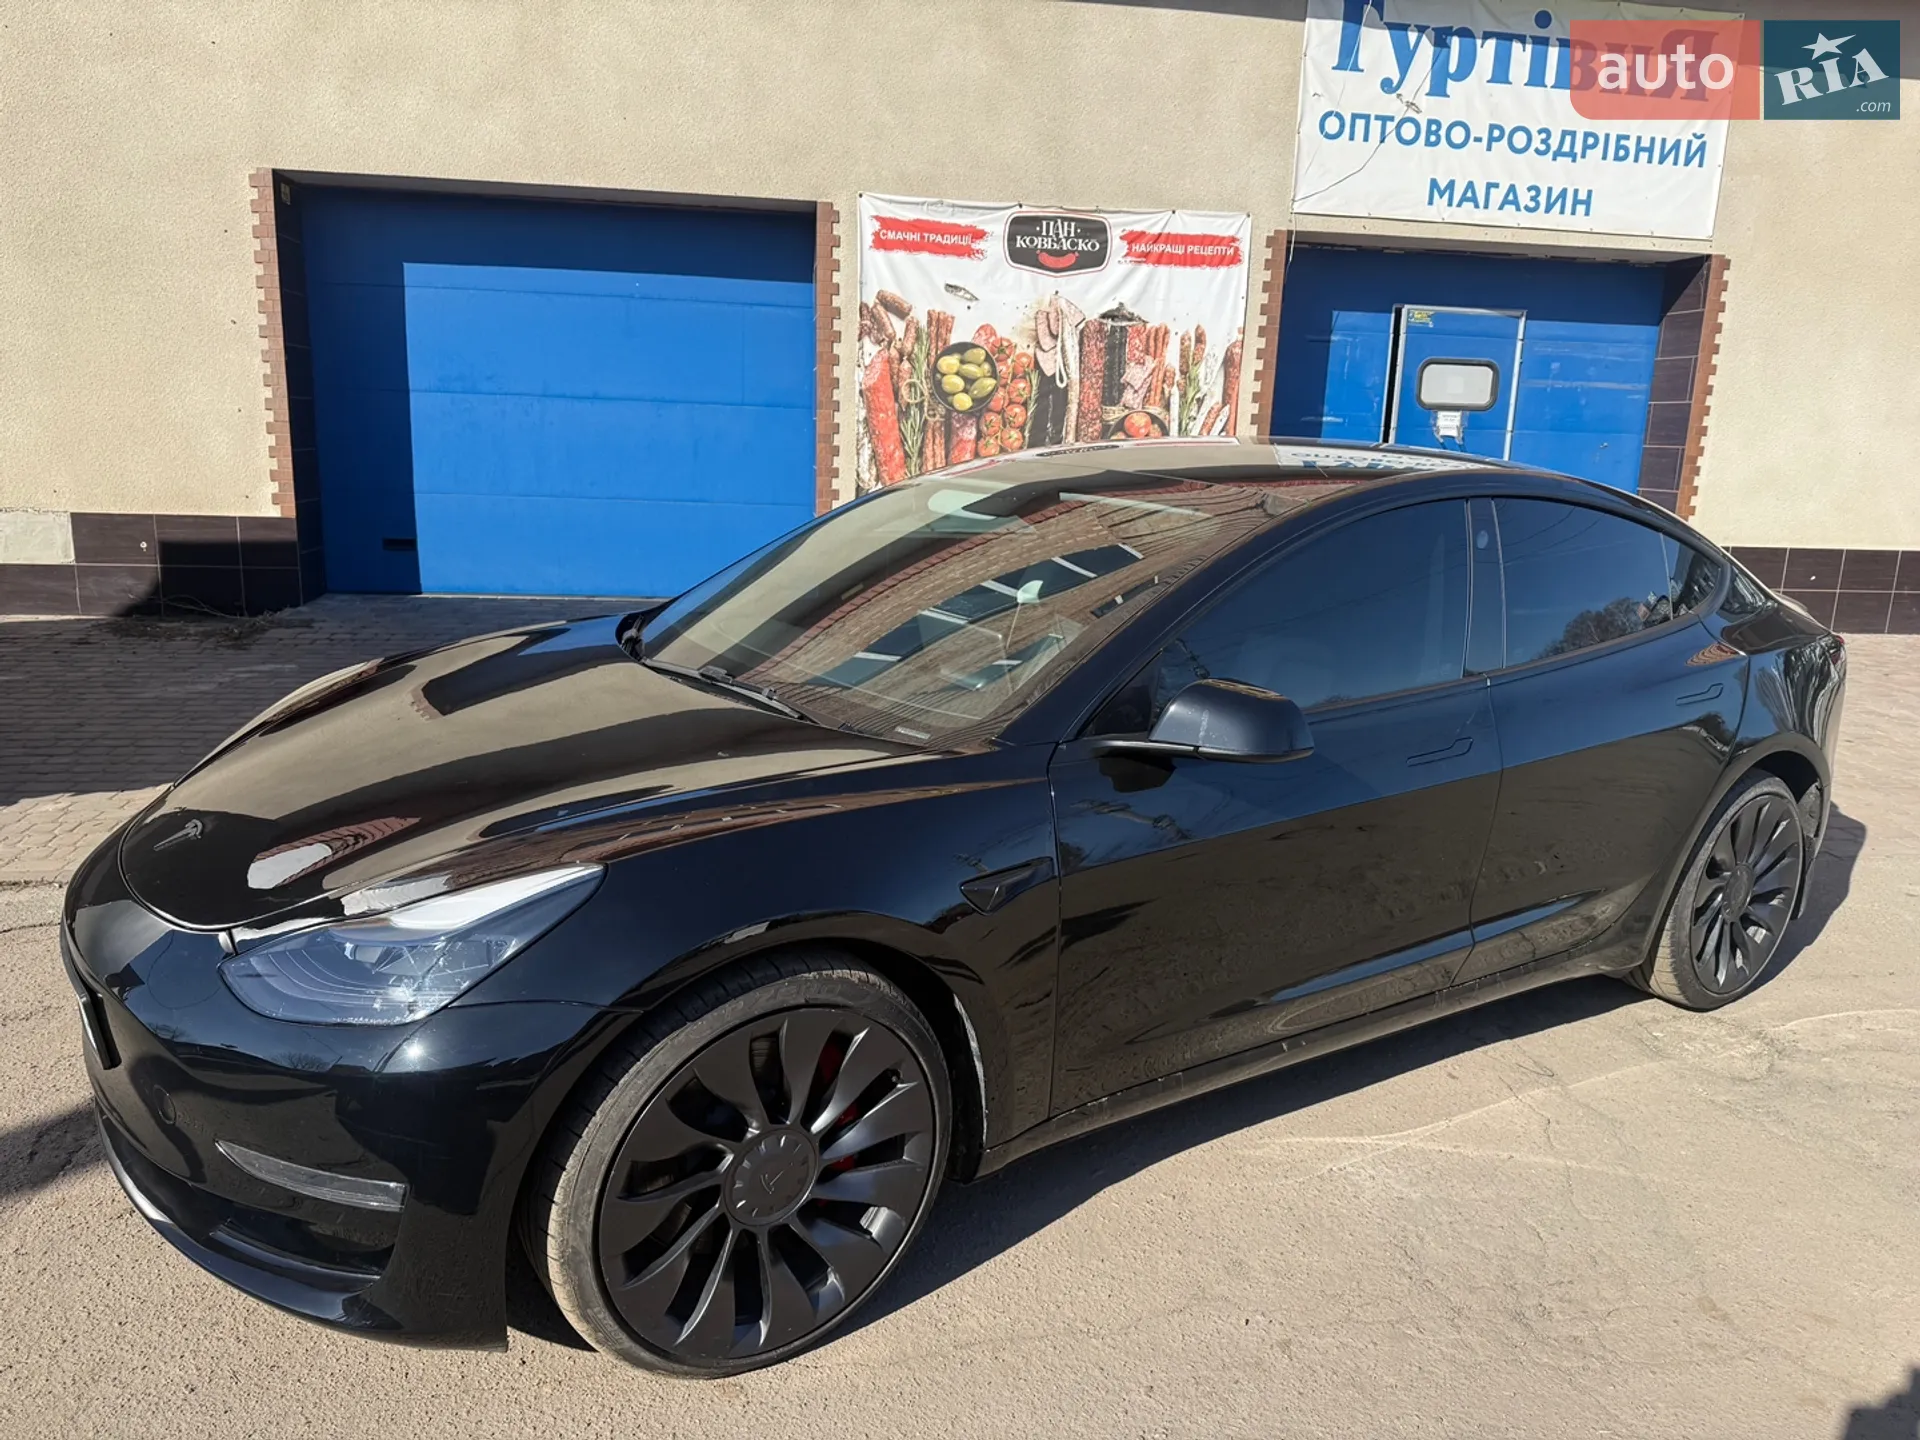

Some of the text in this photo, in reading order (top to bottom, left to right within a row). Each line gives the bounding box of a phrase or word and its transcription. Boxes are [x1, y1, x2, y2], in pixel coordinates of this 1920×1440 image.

[1318, 110, 1708, 168] ОПТОВО-РОЗДРІБНИЙ
[1427, 178, 1593, 217] МАГАЗИН
[879, 229, 920, 241] СМАЧНІ
[1015, 235, 1100, 252] КОВБАСКО
[1131, 241, 1234, 255] НАЙКРАЩІ РЕЦЕПТИ
